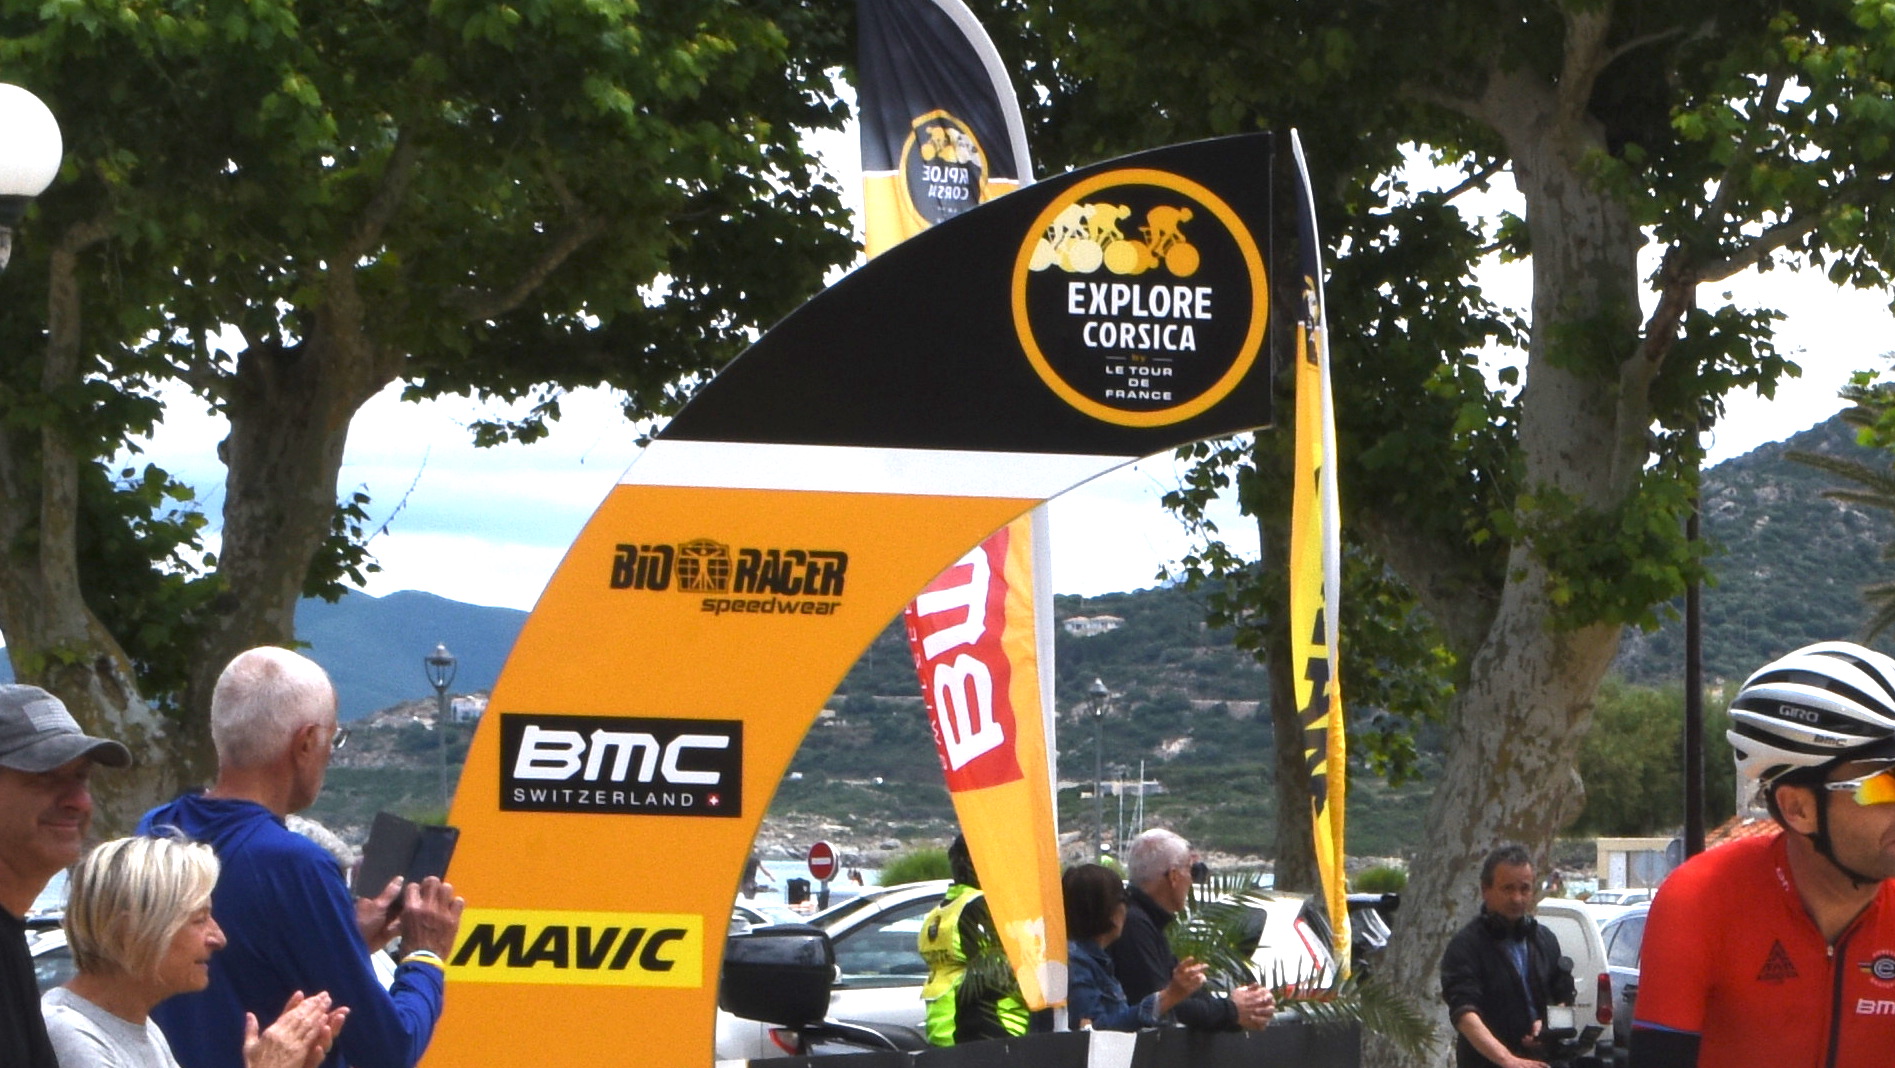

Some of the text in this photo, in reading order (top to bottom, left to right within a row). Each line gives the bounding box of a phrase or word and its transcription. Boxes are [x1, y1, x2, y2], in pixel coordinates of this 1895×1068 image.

[1067, 281, 1213, 321] EXPLORE
[1083, 322, 1197, 352] CORSICA
[1105, 365, 1173, 377] LE TOUR
[1128, 378, 1150, 388] DE
[1105, 389, 1173, 401] FRANCE
[701, 597, 842, 616] speedwear
[1779, 705, 1819, 724] GIRO
[513, 724, 730, 785] BMC
[513, 787, 695, 808] SWITZERLAND
[453, 923, 688, 972] MAVIC
